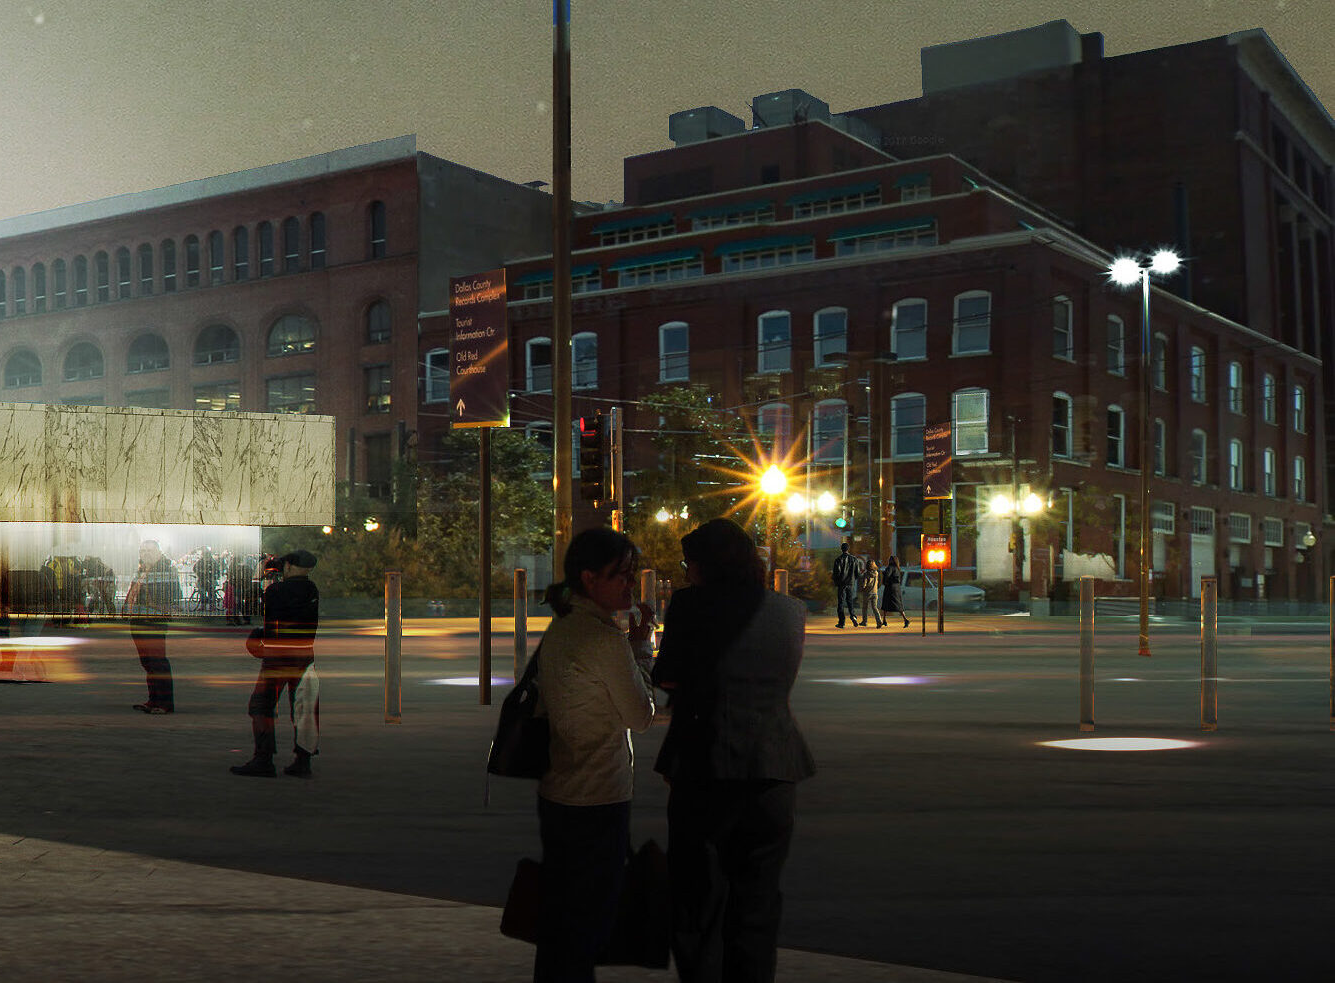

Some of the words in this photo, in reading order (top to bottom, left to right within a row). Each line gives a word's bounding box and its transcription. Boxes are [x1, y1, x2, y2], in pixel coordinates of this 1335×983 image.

[455, 283, 471, 293] Dallas
[473, 280, 491, 290] County
[455, 295, 476, 306] Records
[477, 293, 500, 303] Complex
[456, 318, 473, 328] Tourist
[456, 329, 485, 341] Information
[456, 352, 467, 362] Old
[468, 350, 478, 360] Red
[456, 365, 486, 376] Courthouse
